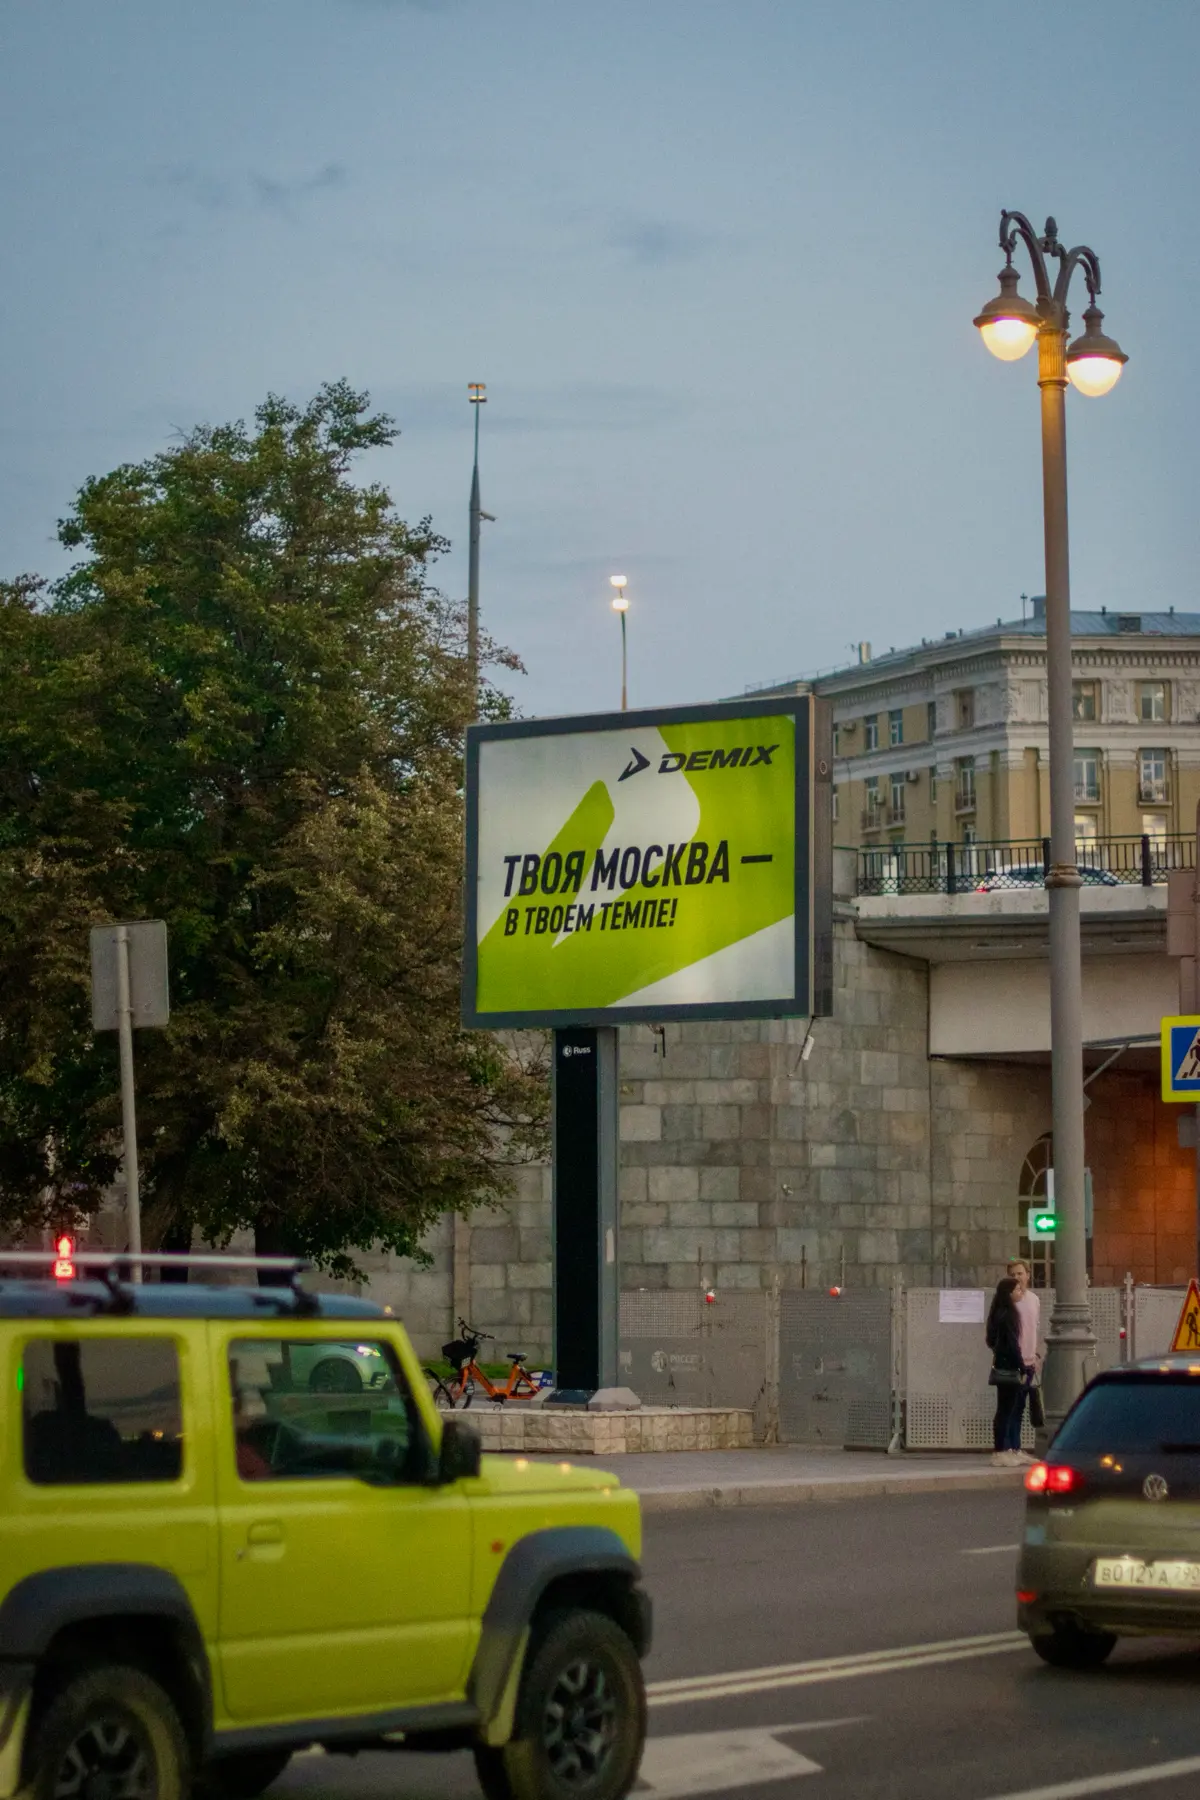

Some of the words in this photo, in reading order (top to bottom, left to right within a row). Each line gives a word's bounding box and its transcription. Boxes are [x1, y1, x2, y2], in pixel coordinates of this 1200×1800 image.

[657, 744, 780, 774] DEMIX
[503, 850, 586, 897] ТВОЯ
[590, 840, 730, 892] МОСКВА
[504, 908, 519, 936] В
[524, 903, 595, 934] ТВОЕМ
[600, 898, 678, 931] ТЕМПЕ!
